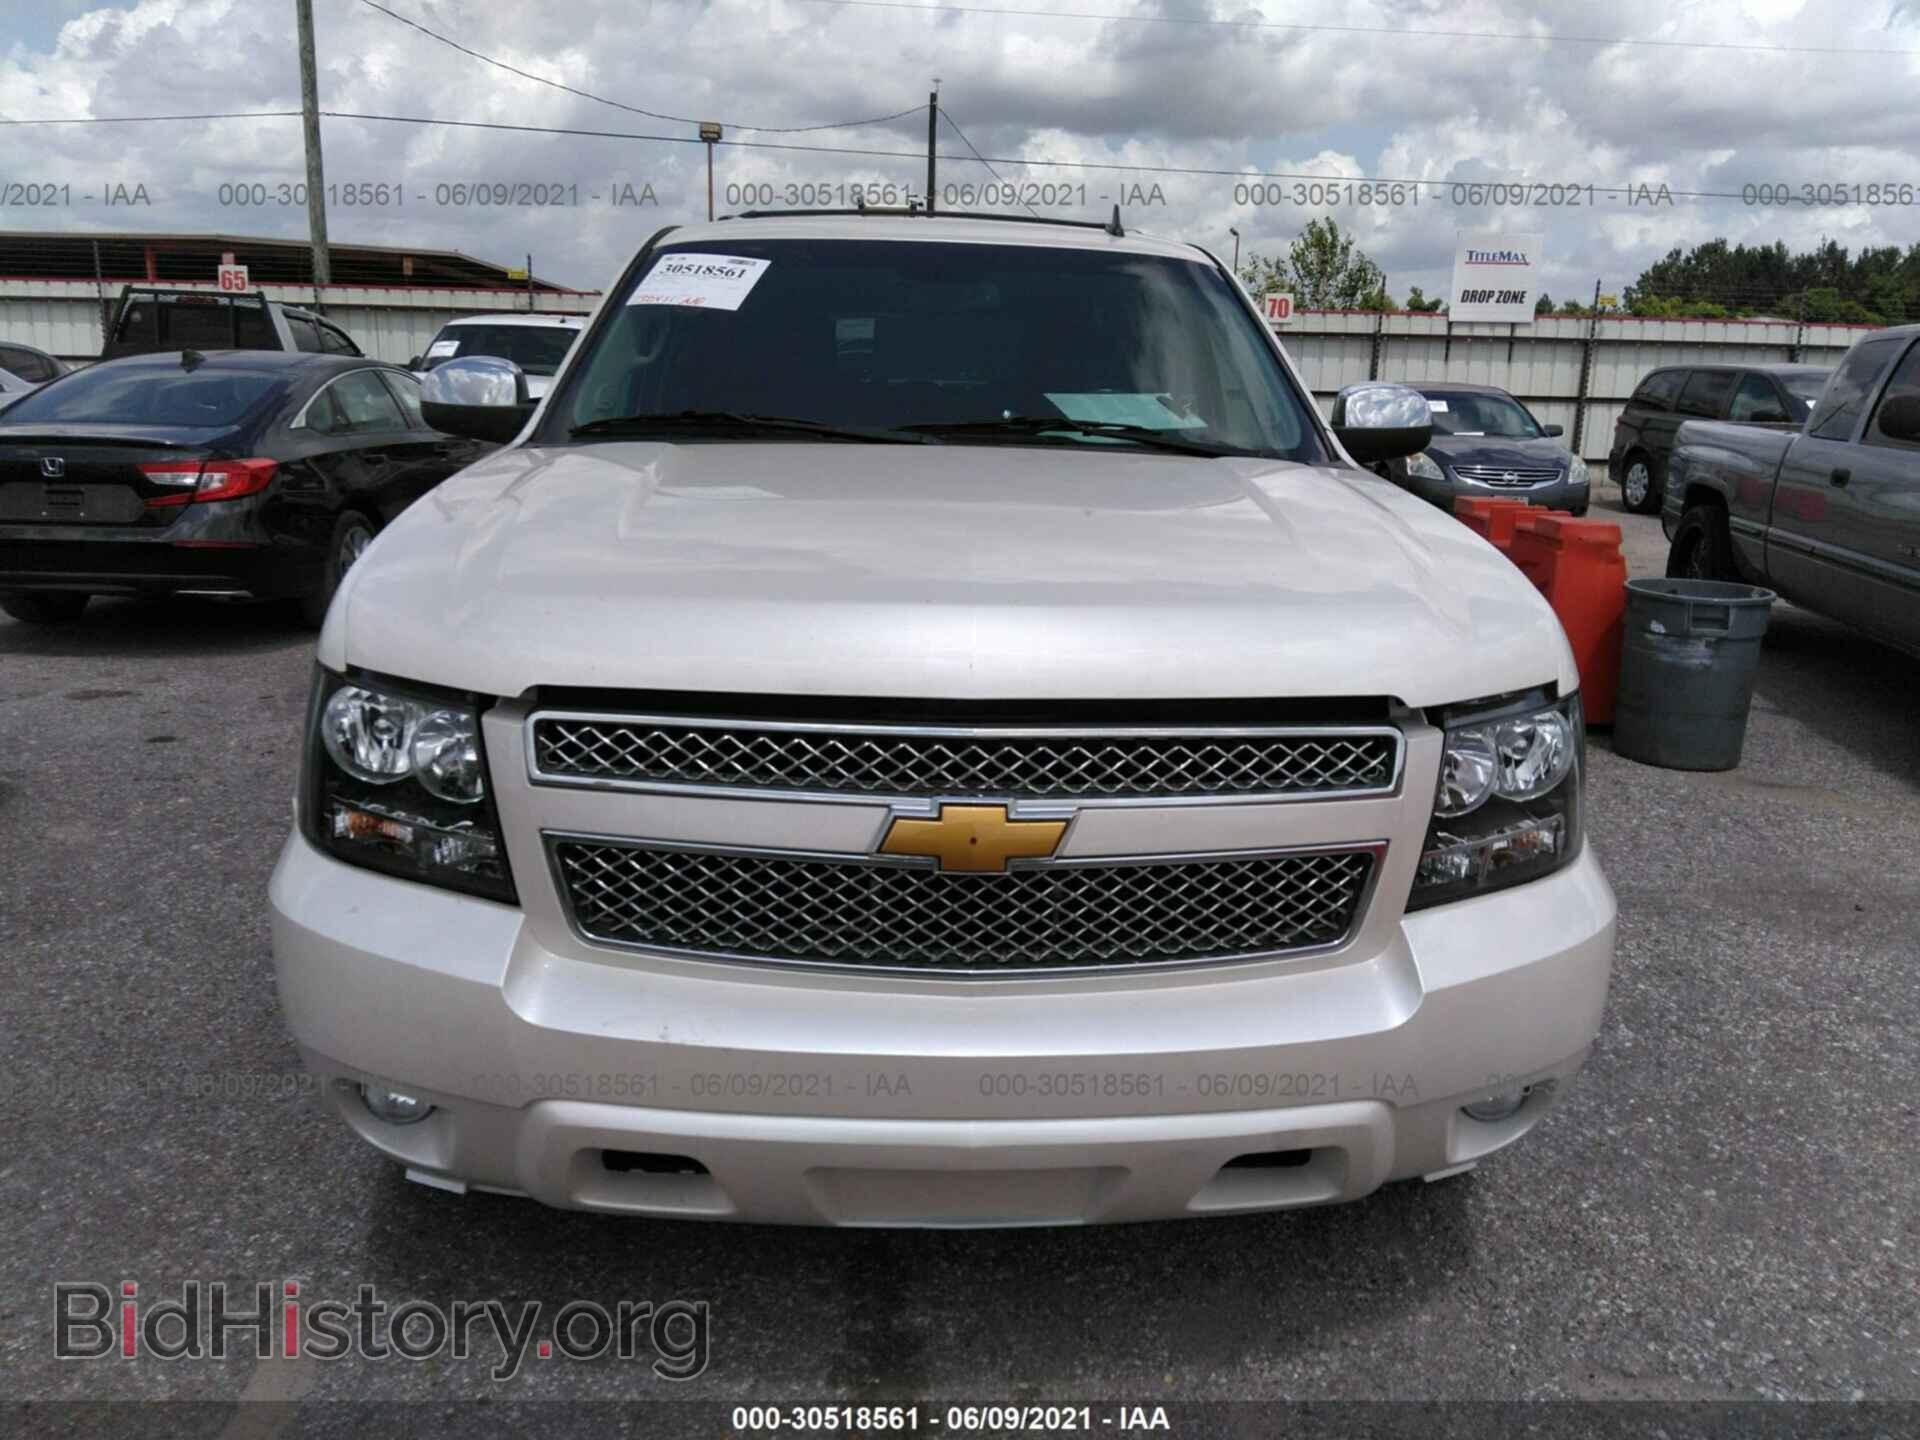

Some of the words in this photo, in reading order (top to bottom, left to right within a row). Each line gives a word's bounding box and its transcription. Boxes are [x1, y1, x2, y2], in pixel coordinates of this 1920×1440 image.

[221, 269, 246, 291] 65
[660, 263, 747, 279] 30518561
[1460, 289, 1496, 304] DROP
[1495, 290, 1527, 305] ZONE
[1267, 297, 1290, 319] 70
